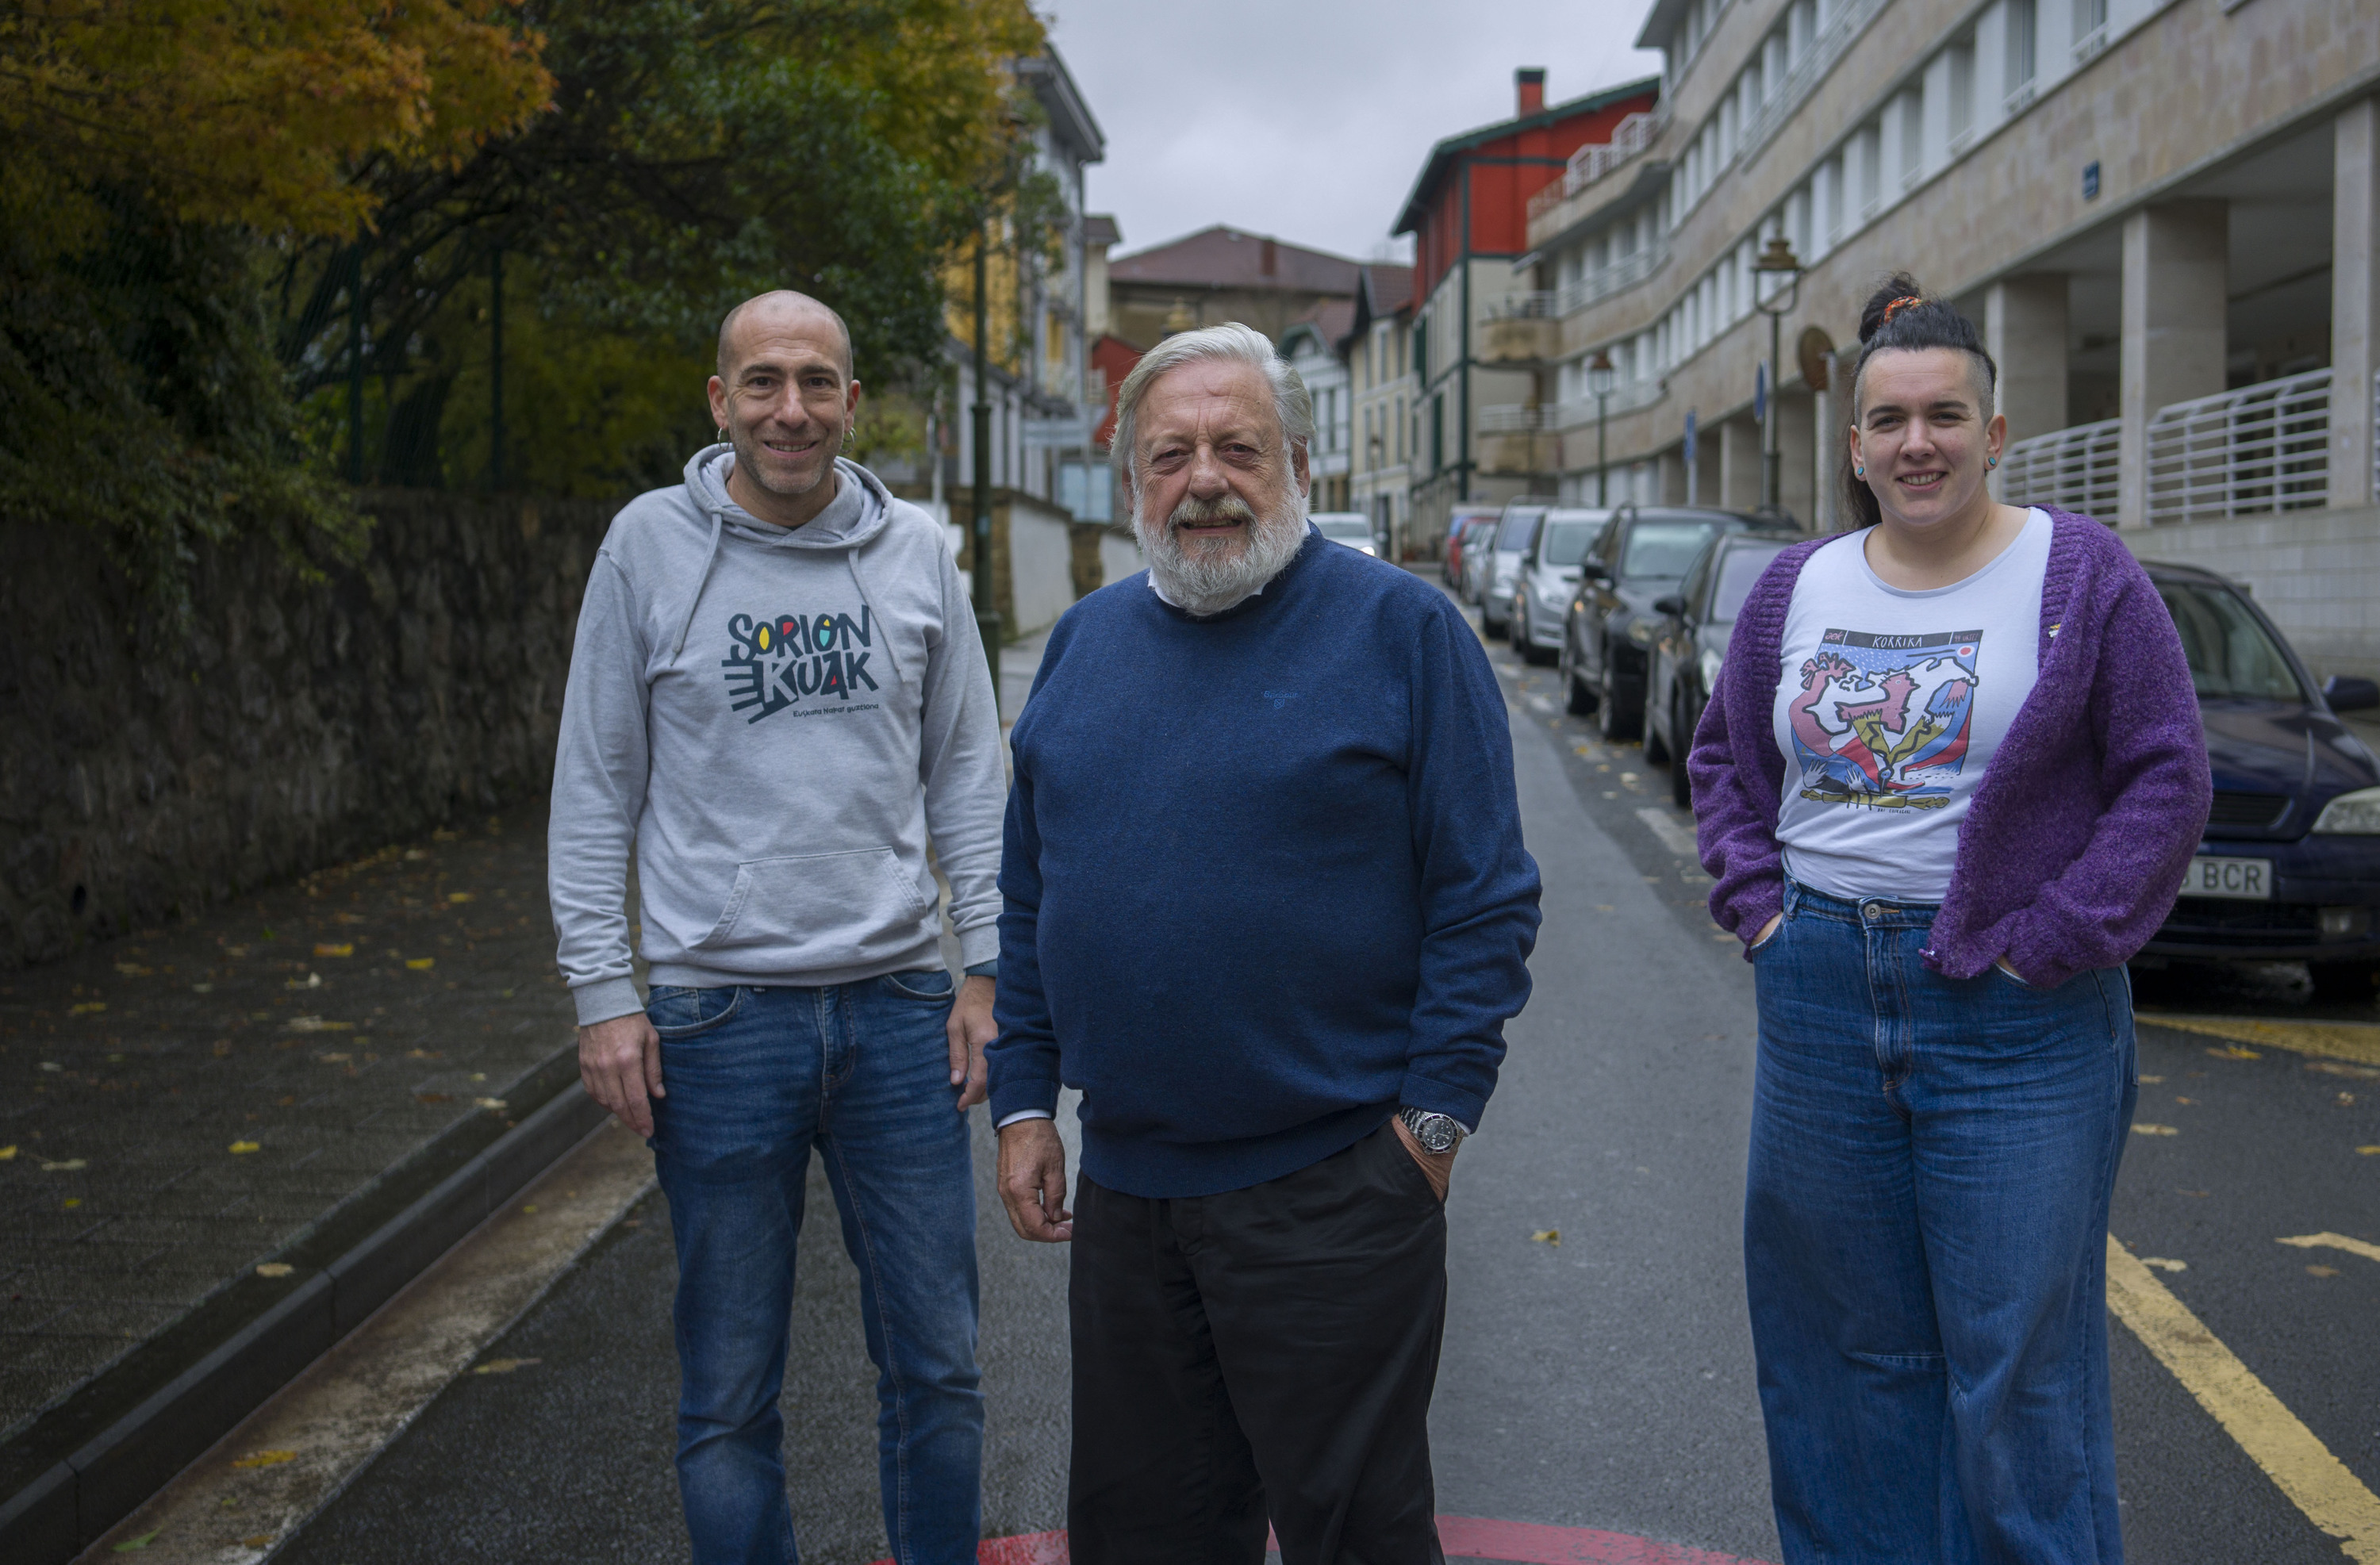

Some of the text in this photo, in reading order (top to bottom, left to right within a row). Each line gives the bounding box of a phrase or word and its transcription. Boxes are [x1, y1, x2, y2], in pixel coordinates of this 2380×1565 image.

[728, 604, 871, 661] SORION
[1871, 635, 1922, 648] KORRIKA
[846, 704, 879, 713] guztiona
[2202, 862, 2260, 892] BCR
